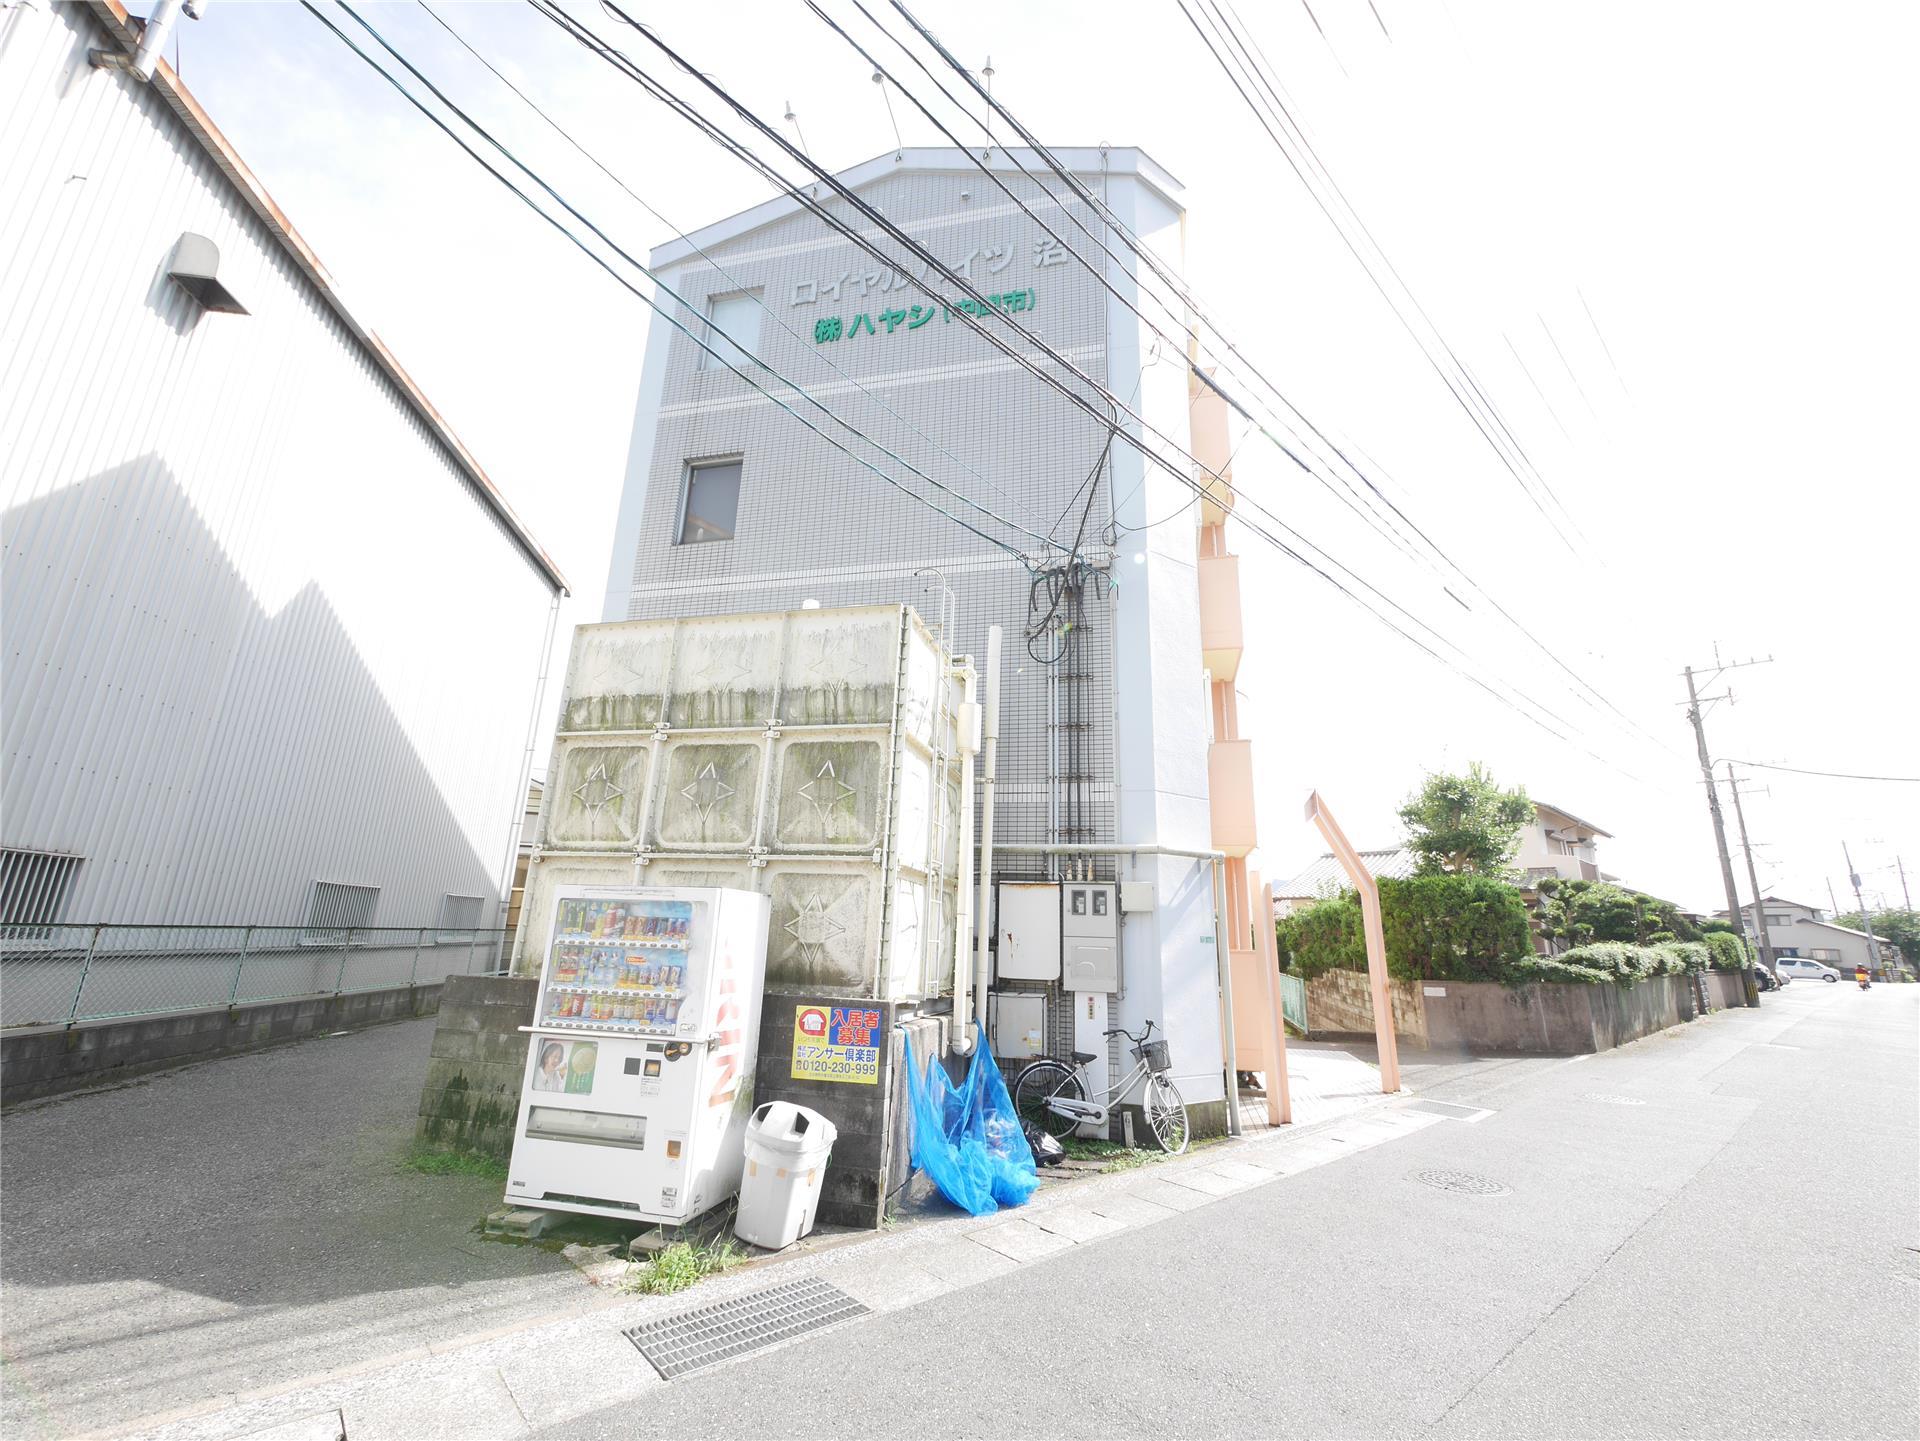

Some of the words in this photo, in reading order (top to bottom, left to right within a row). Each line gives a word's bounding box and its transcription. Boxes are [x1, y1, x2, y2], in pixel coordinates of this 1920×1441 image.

[831, 1009, 879, 1029] 入居者
[837, 1027, 871, 1046] 募集
[803, 1060, 876, 1075] 0120-230-999
